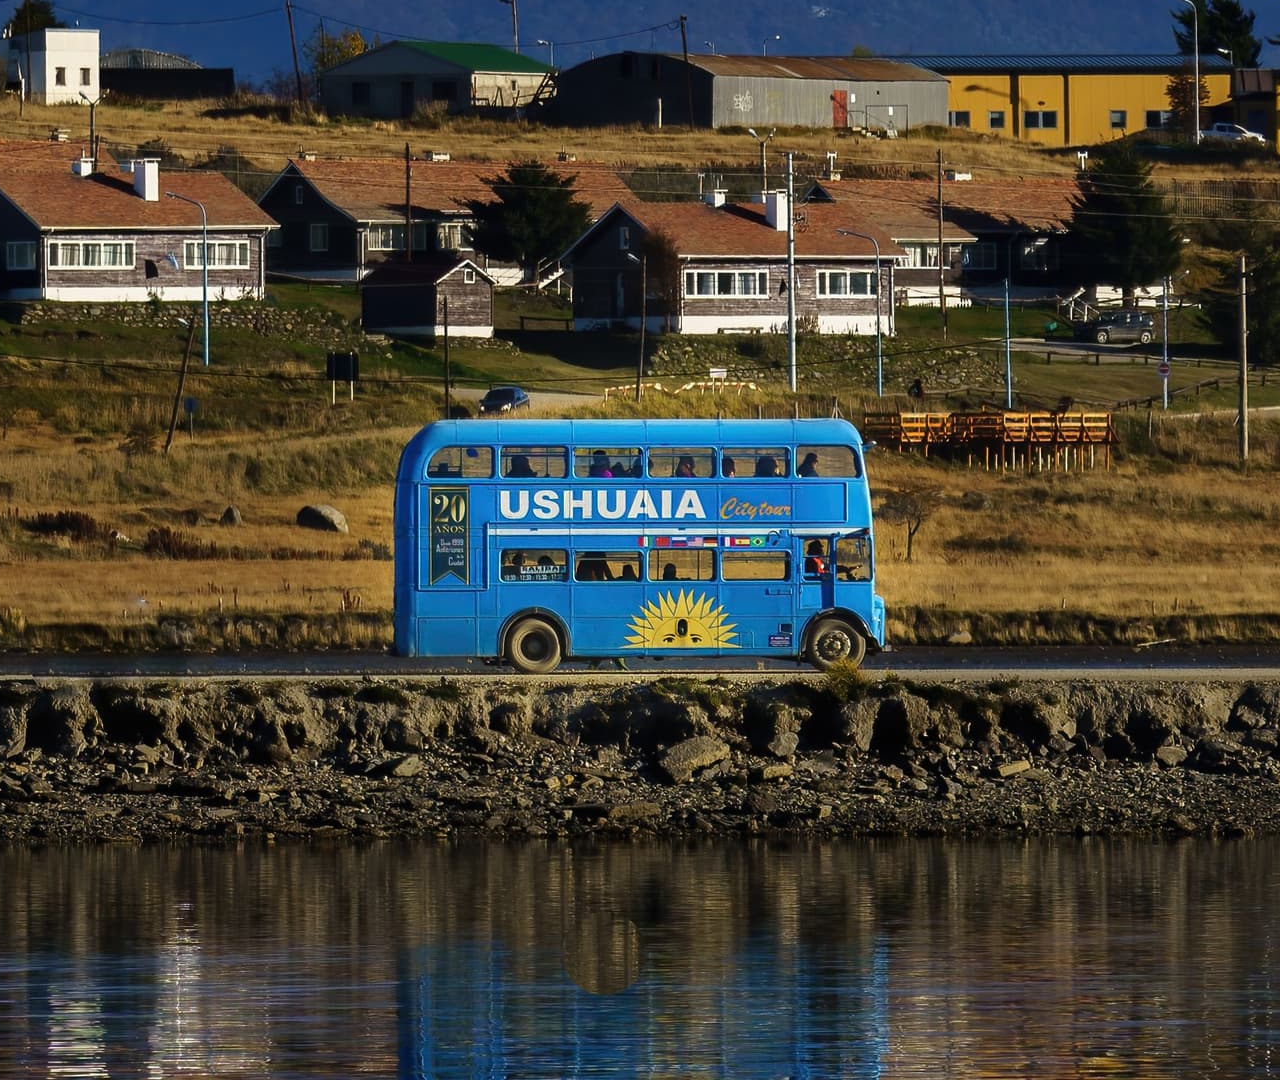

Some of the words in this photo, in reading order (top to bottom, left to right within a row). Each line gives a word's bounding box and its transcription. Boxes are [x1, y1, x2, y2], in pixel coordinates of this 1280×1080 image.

[434, 494, 466, 523] 20
[500, 489, 707, 520] USHUAIA
[435, 523, 465, 534] AÑOS
